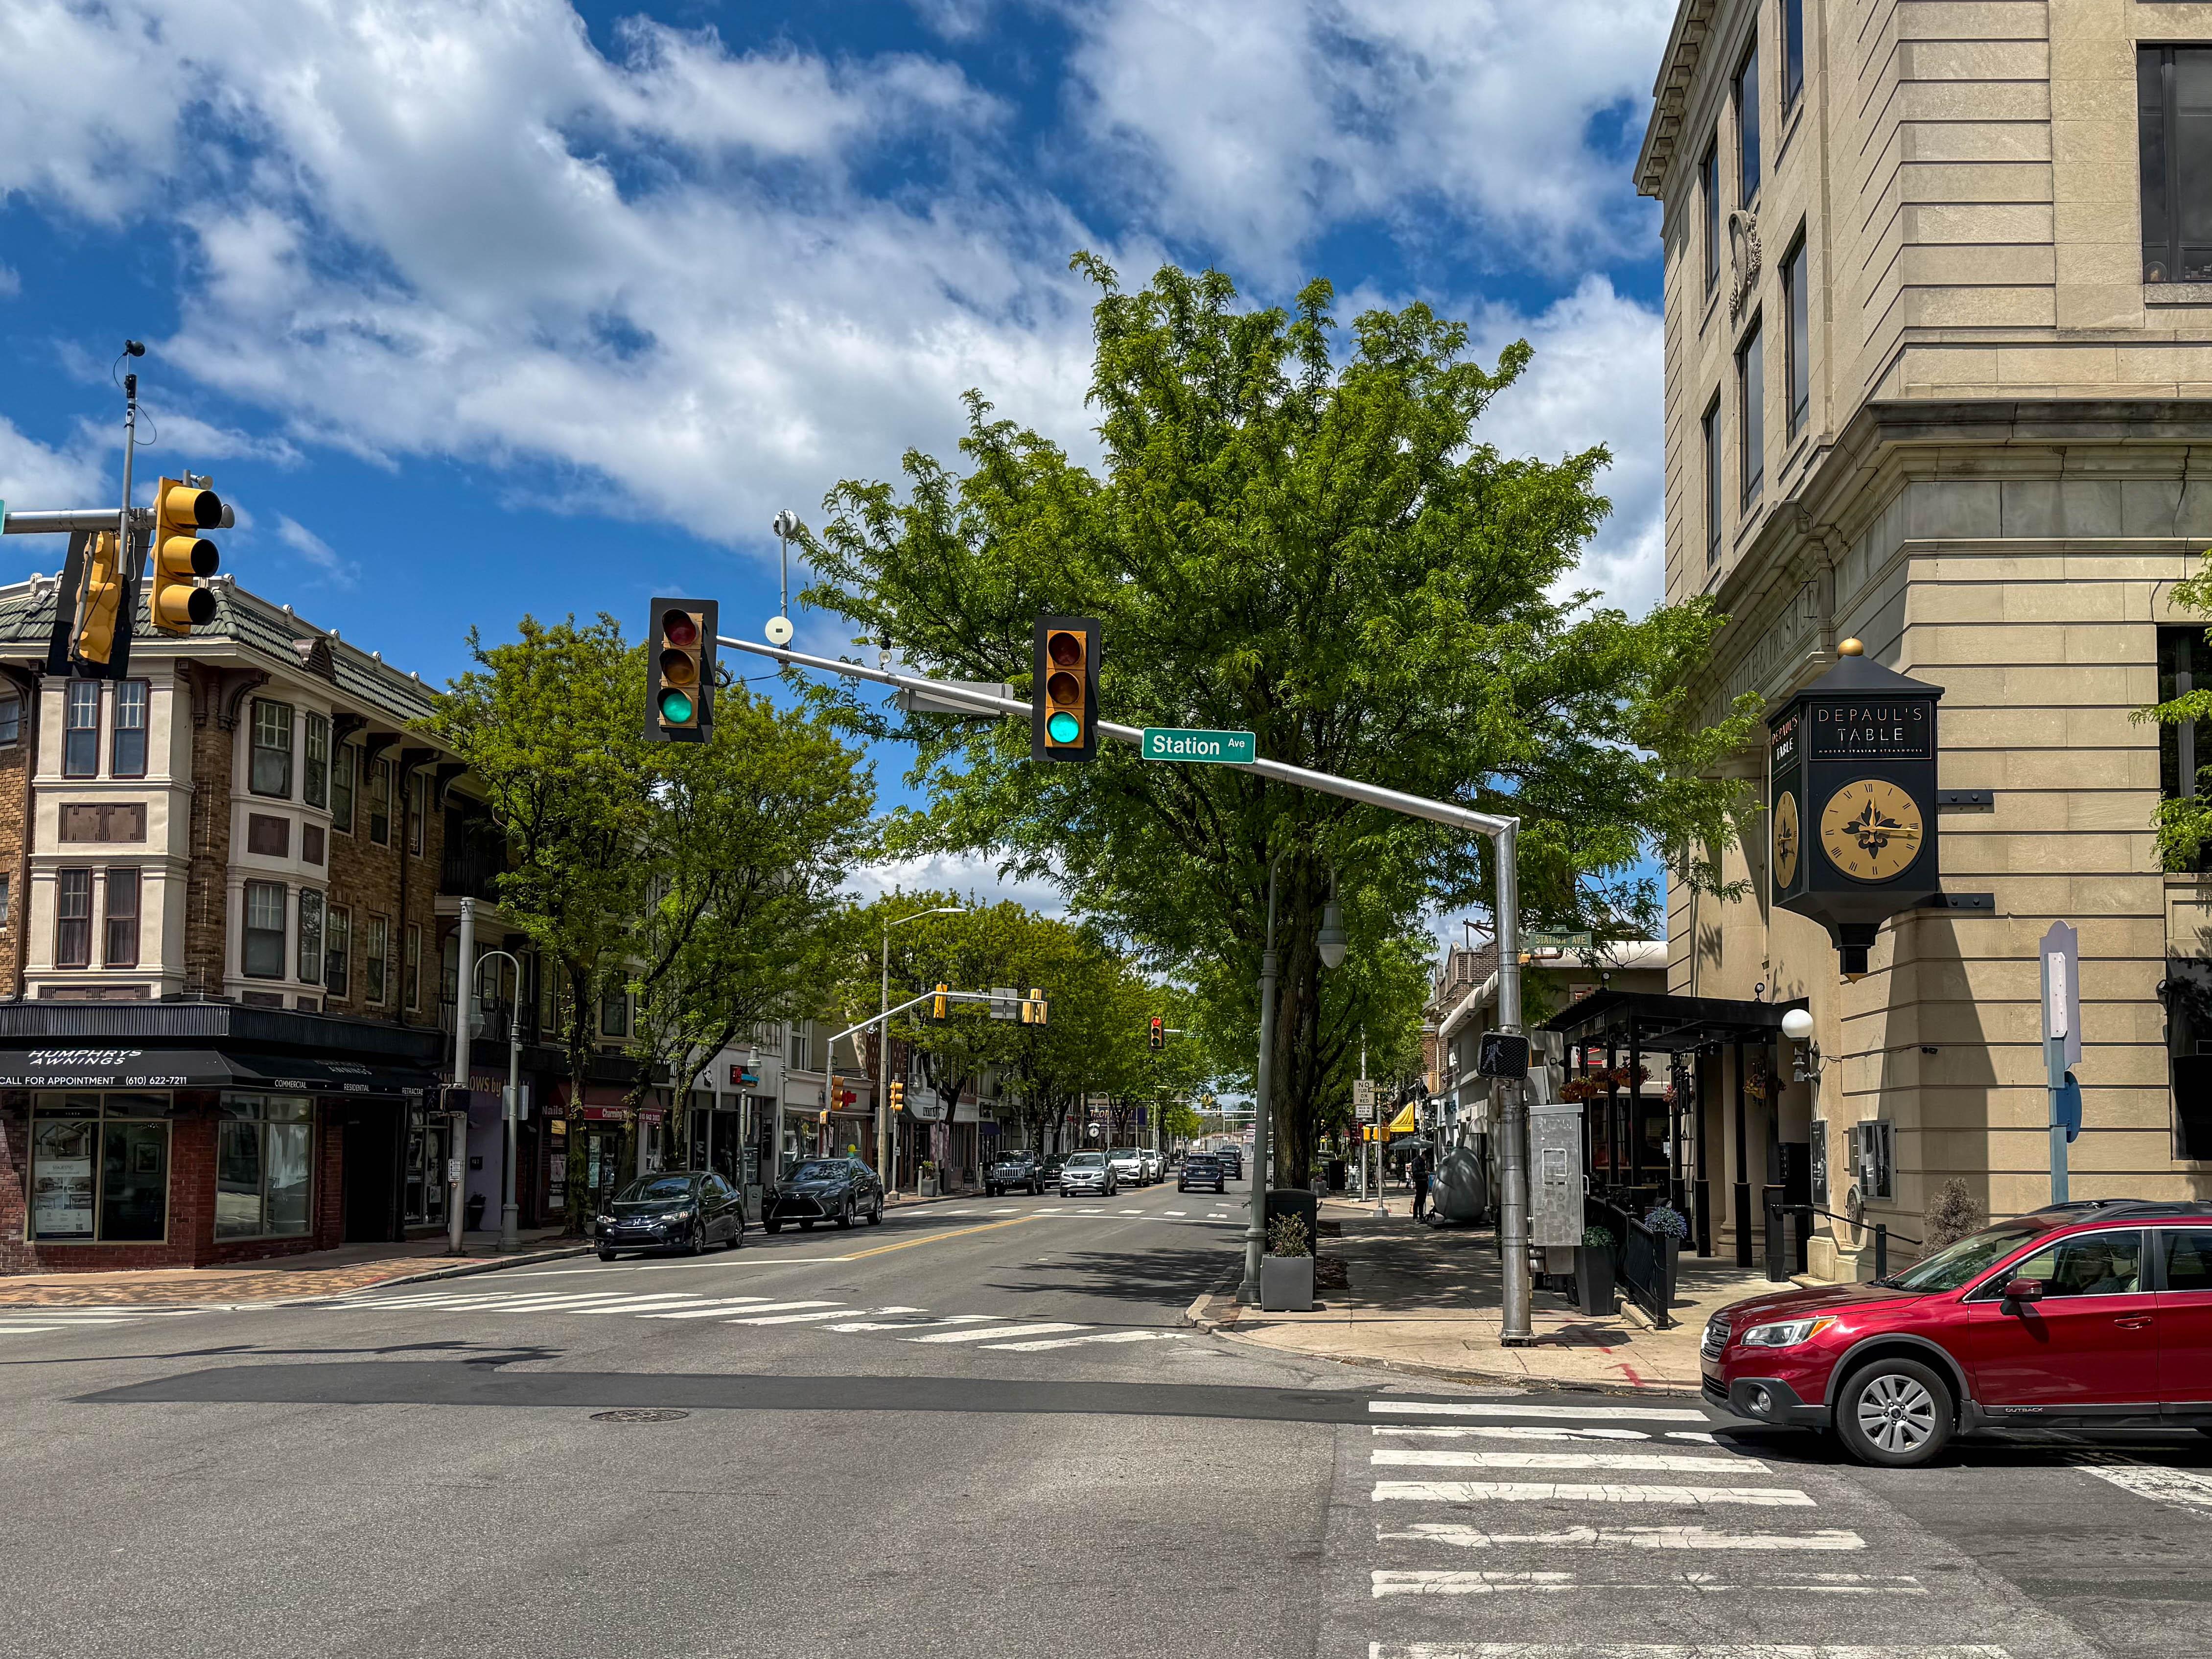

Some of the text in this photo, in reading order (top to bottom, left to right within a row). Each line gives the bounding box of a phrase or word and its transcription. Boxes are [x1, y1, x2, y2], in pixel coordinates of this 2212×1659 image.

[1819, 708, 1922, 722] DEPAUL'S
[1772, 715, 1797, 745] DEPAUL'S
[1838, 727, 1903, 742] TABLE
[1153, 735, 1245, 755] Station Ave
[1776, 737, 1793, 760] TABLE
[1536, 935, 1566, 945] STATION
[28, 1050, 143, 1058] HUMPHRYS
[0, 1076, 187, 1086] CALL FOR APPOINTMENT (610) 622-7211
[275, 1079, 307, 1089] COMMERCIAL
[469, 1076, 490, 1092] OWS
[491, 1076, 502, 1098] by
[542, 1105, 563, 1116] Nails
